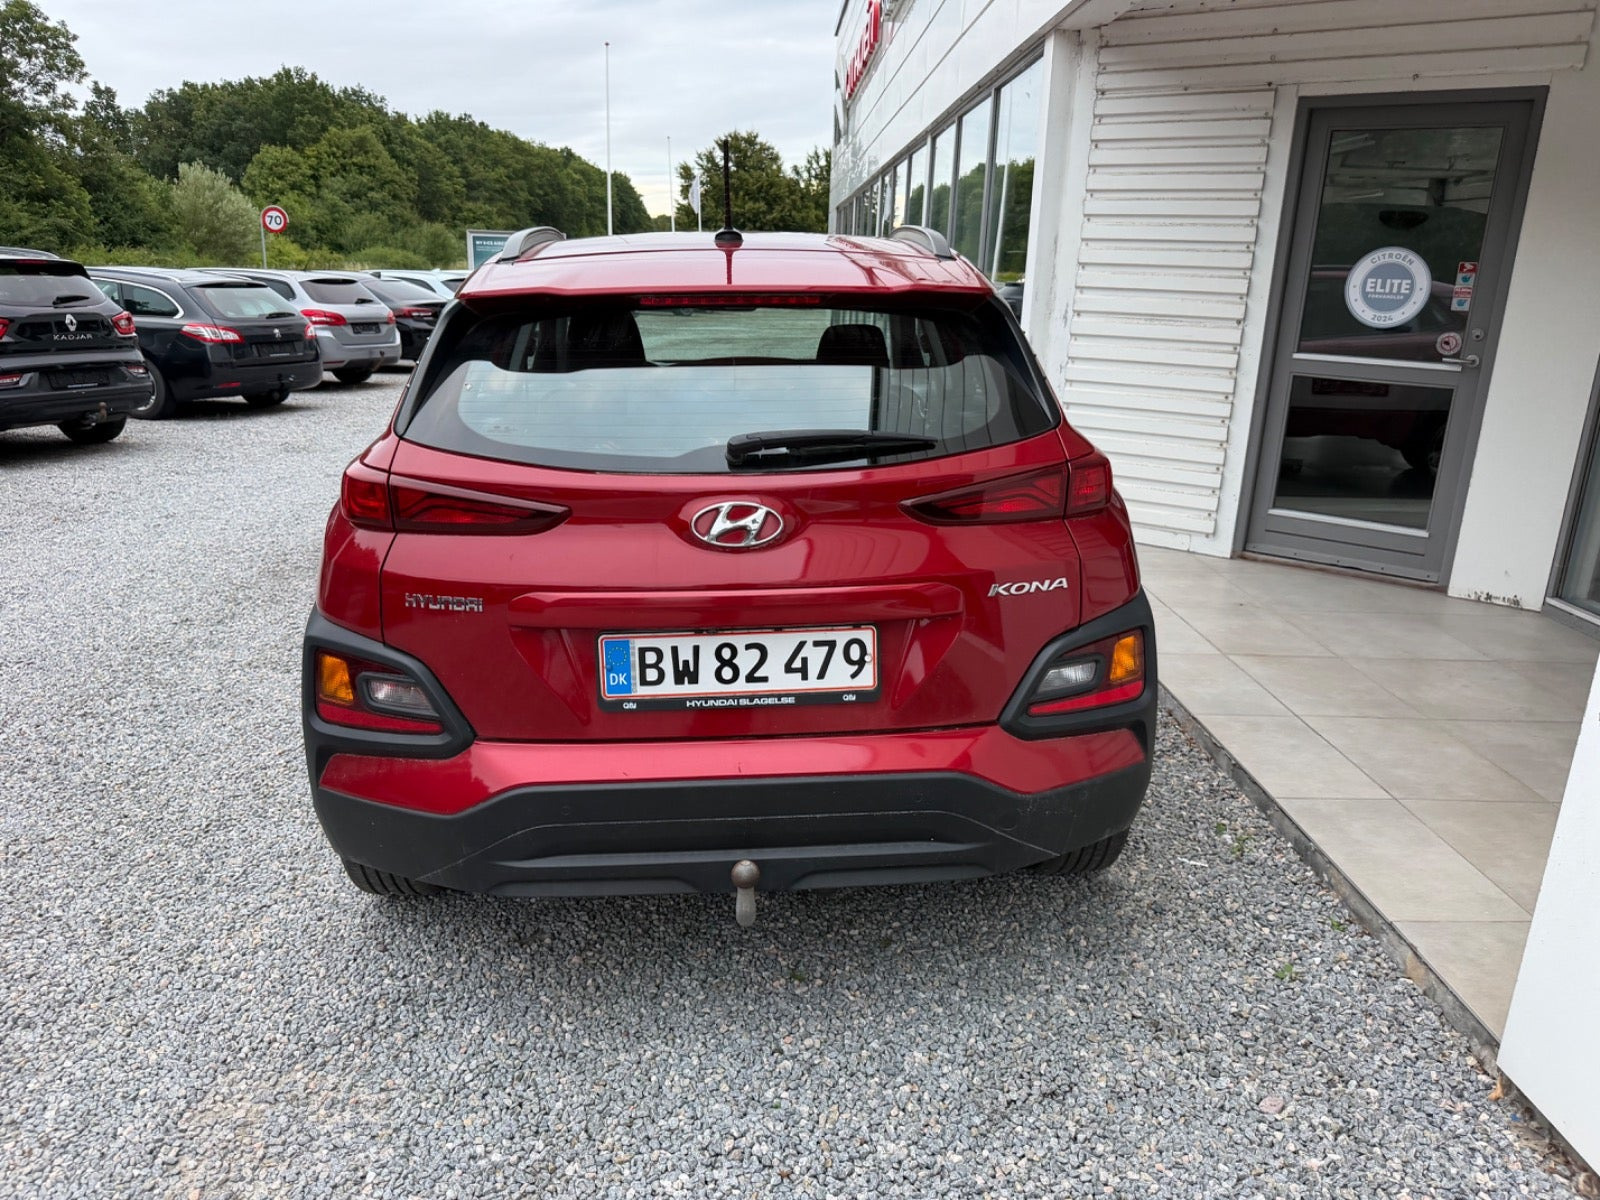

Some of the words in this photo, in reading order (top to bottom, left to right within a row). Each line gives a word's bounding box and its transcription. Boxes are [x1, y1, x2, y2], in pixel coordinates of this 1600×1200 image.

[267, 215, 282, 225] 70
[1370, 252, 1415, 266] CITROËN
[1365, 278, 1412, 294] ELITE
[1371, 314, 1394, 322] 2024
[987, 577, 1068, 597] KONA
[404, 592, 483, 612] HYUNDAI
[638, 645, 700, 687] BW
[714, 642, 769, 685] 82
[784, 638, 868, 681] 479
[610, 673, 628, 686] DK
[686, 698, 738, 708] HYUNDAI
[739, 696, 796, 706] SLAGELSE
